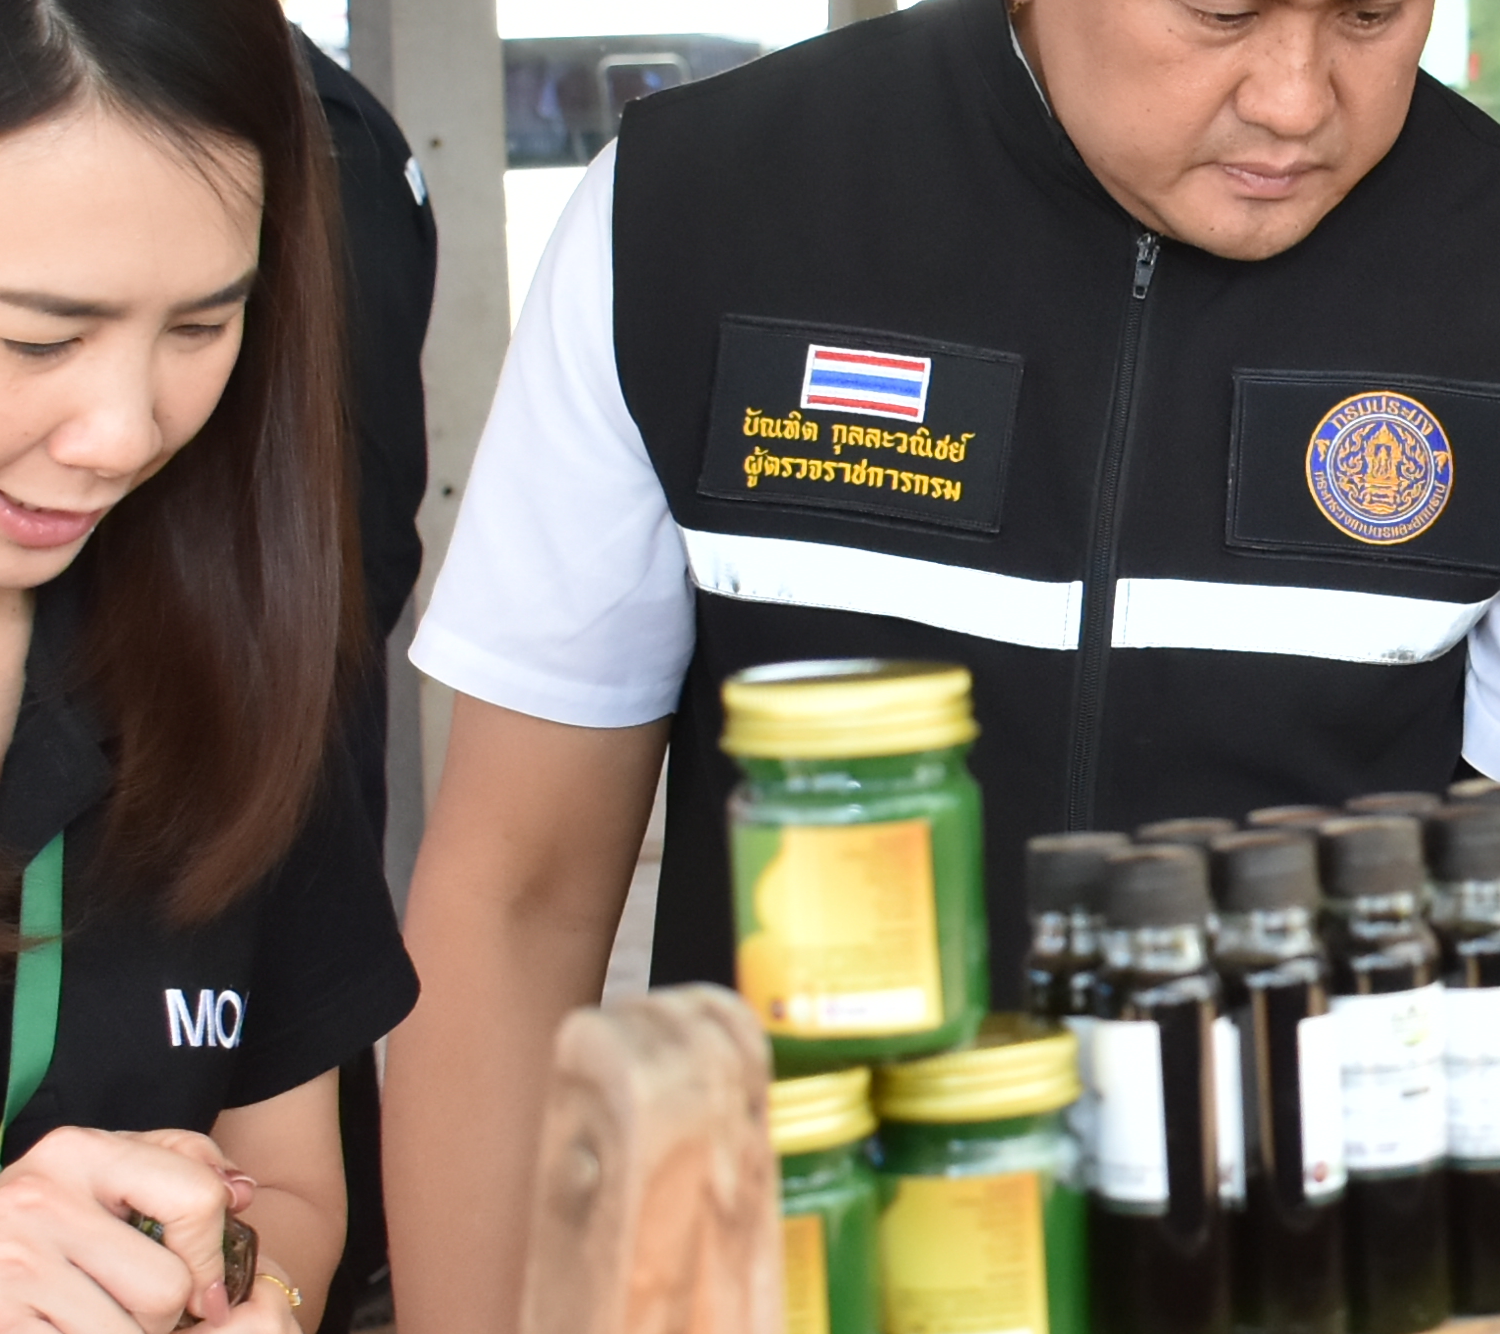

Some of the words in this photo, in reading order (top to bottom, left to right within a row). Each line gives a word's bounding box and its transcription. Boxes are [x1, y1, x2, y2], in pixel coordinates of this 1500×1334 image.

[743, 406, 819, 442] บัณฑิต
[1330, 396, 1434, 436] กรมประมง
[743, 446, 963, 502] ผู้ตรวจราชการกรม
